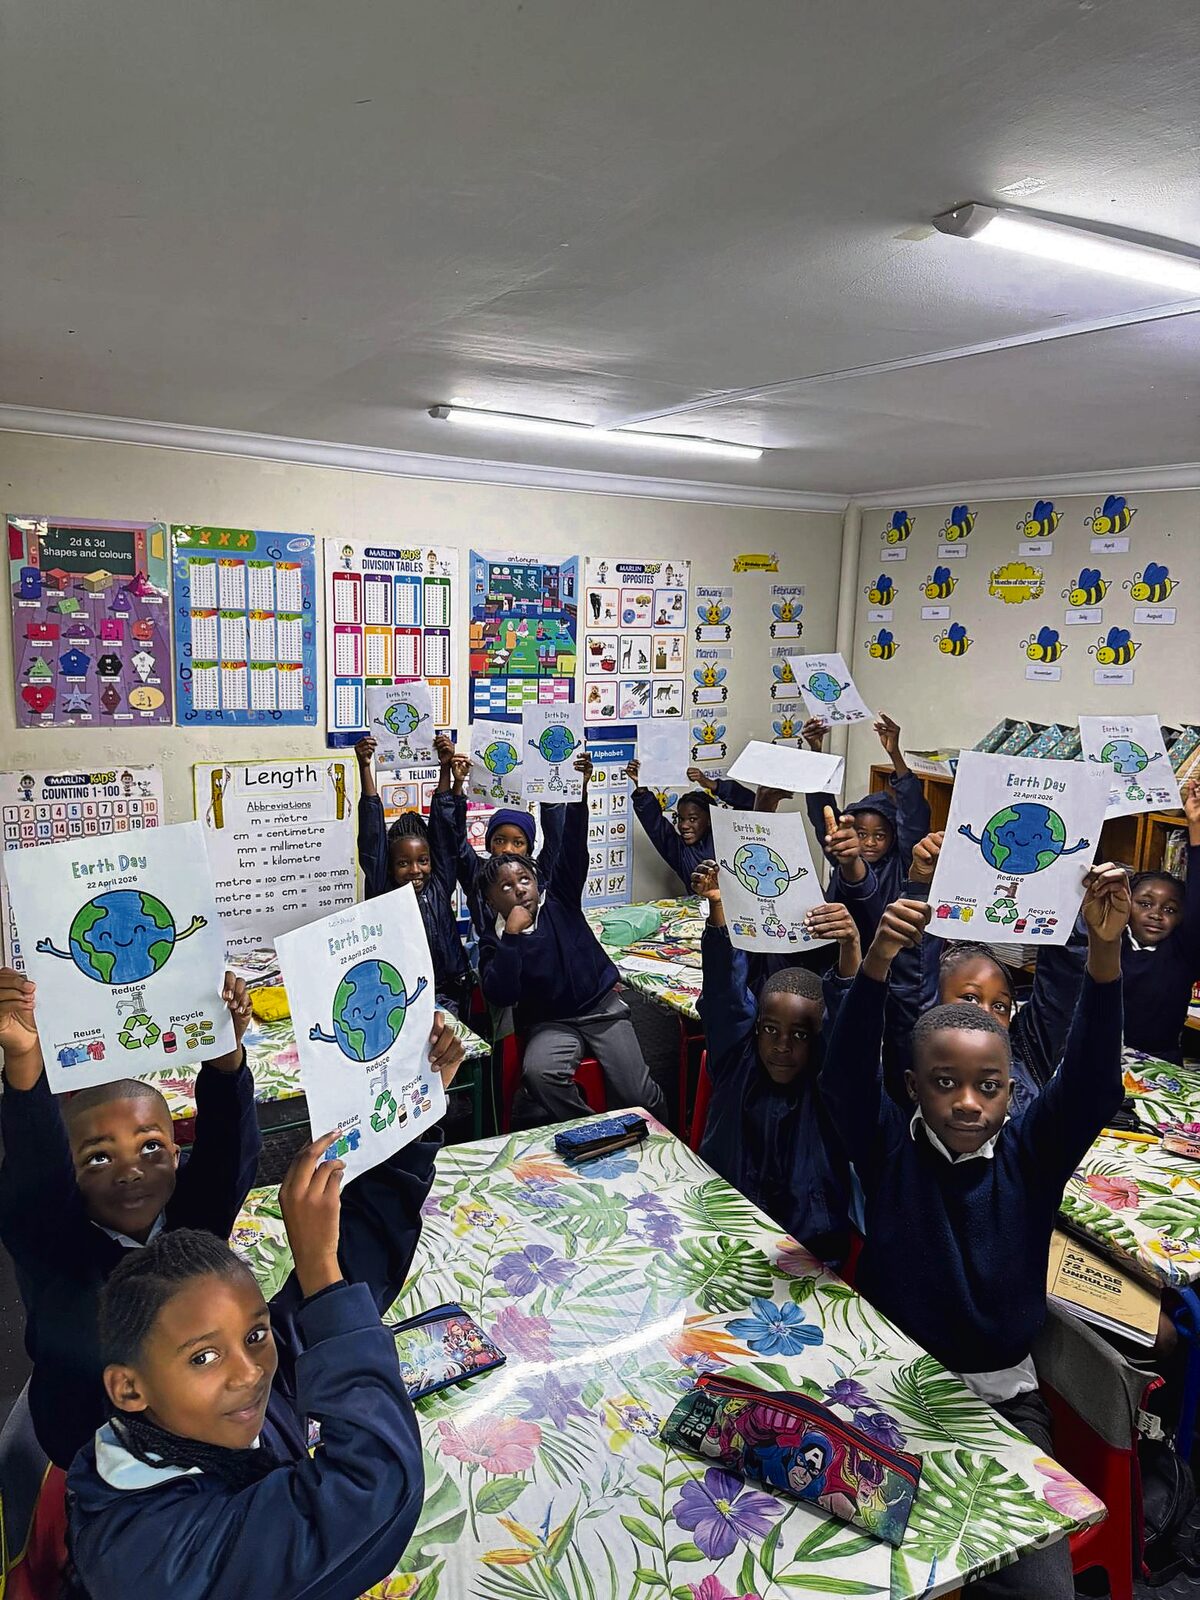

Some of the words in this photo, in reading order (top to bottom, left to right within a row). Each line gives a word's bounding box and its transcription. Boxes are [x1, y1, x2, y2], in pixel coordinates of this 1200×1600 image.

[70, 537, 82, 547] 2d
[84, 538, 92, 547] &
[94, 538, 106, 548] 3d
[43, 547, 78, 558] shapes
[79, 549, 97, 558] and
[99, 550, 132, 560] colours
[369, 549, 397, 558] MARLIN
[400, 549, 421, 561] KIDS
[362, 559, 395, 571] DIVISION
[396, 561, 423, 573] TABLES
[508, 556, 539, 567] antonyms
[622, 574, 655, 584] OPPOSITES
[697, 587, 722, 597] January
[773, 585, 802, 596] February
[696, 648, 718, 659] March
[777, 703, 797, 712] June
[544, 711, 559, 719] Earth
[560, 712, 570, 720] Day
[1102, 725, 1120, 734] Earth
[594, 749, 624, 759] Alphabet
[50, 777, 86, 785] MARLIN
[90, 772, 116, 785] KIDS
[245, 764, 318, 789] Length
[409, 770, 437, 780] TELLING
[1006, 773, 1040, 788] Earth
[1043, 777, 1067, 793] Day
[42, 787, 89, 800] COUNTING
[1021, 792, 1037, 800] April
[9, 810, 14, 819] 1
[24, 809, 30, 818] 2
[40, 808, 46, 817] 3
[56, 807, 62, 816] 4
[71, 806, 77, 815] 5
[87, 806, 93, 815] 6
[102, 805, 108, 813] 7
[117, 804, 123, 813] 8
[133, 803, 138, 812] 9
[145, 803, 155, 812] 10
[247, 801, 312, 812] Abbreviations
[274, 815, 308, 824] metre
[8, 827, 17, 837] 11
[23, 826, 33, 835] 12
[39, 825, 49, 835] 13
[55, 825, 65, 834] 14
[70, 823, 81, 833] 15
[86, 822, 96, 832] 16
[101, 821, 111, 831] 17
[116, 820, 126, 830] 18
[131, 819, 141, 828] 19
[145, 819, 156, 828] 20
[266, 827, 325, 838] centimetre
[732, 821, 754, 833] Earth
[755, 824, 771, 836] Day
[237, 846, 257, 854] mm
[270, 841, 322, 852] millimetre
[71, 858, 115, 879] Earth
[118, 854, 147, 872] Day
[240, 858, 255, 868] km
[272, 855, 321, 866] kilometre
[86, 881, 96, 889] 22
[98, 878, 117, 889] April
[118, 875, 138, 885] 2026
[215, 877, 252, 888] metre
[280, 873, 296, 882] cm
[330, 869, 349, 878] mm
[996, 874, 1025, 883] Reduce
[215, 892, 252, 903] metre
[334, 883, 353, 891] mm
[955, 895, 977, 904] Reuse
[282, 903, 298, 911] cm
[335, 896, 353, 904] mm
[1028, 907, 1056, 916] Recycle
[226, 936, 263, 947] metre
[328, 930, 359, 956] Earth
[361, 923, 383, 942] Day
[340, 957, 347, 965] 22
[348, 950, 362, 961] April
[362, 944, 377, 955] 2026
[15, 961, 25, 970] 91
[111, 984, 146, 996] Reduce
[169, 1010, 204, 1023] Recycle
[73, 1027, 101, 1039] Reuse
[366, 1055, 390, 1074] Reduce
[401, 1074, 422, 1093] Recycle
[337, 1114, 359, 1129] Reuse
[1066, 1254, 1085, 1263] A4
[1062, 1267, 1122, 1294] UNRULED
[1064, 1261, 1081, 1271] 72
[1084, 1267, 1123, 1287] PAGE
[680, 1401, 706, 1435] SINCE
[691, 1406, 714, 1438] 1963
